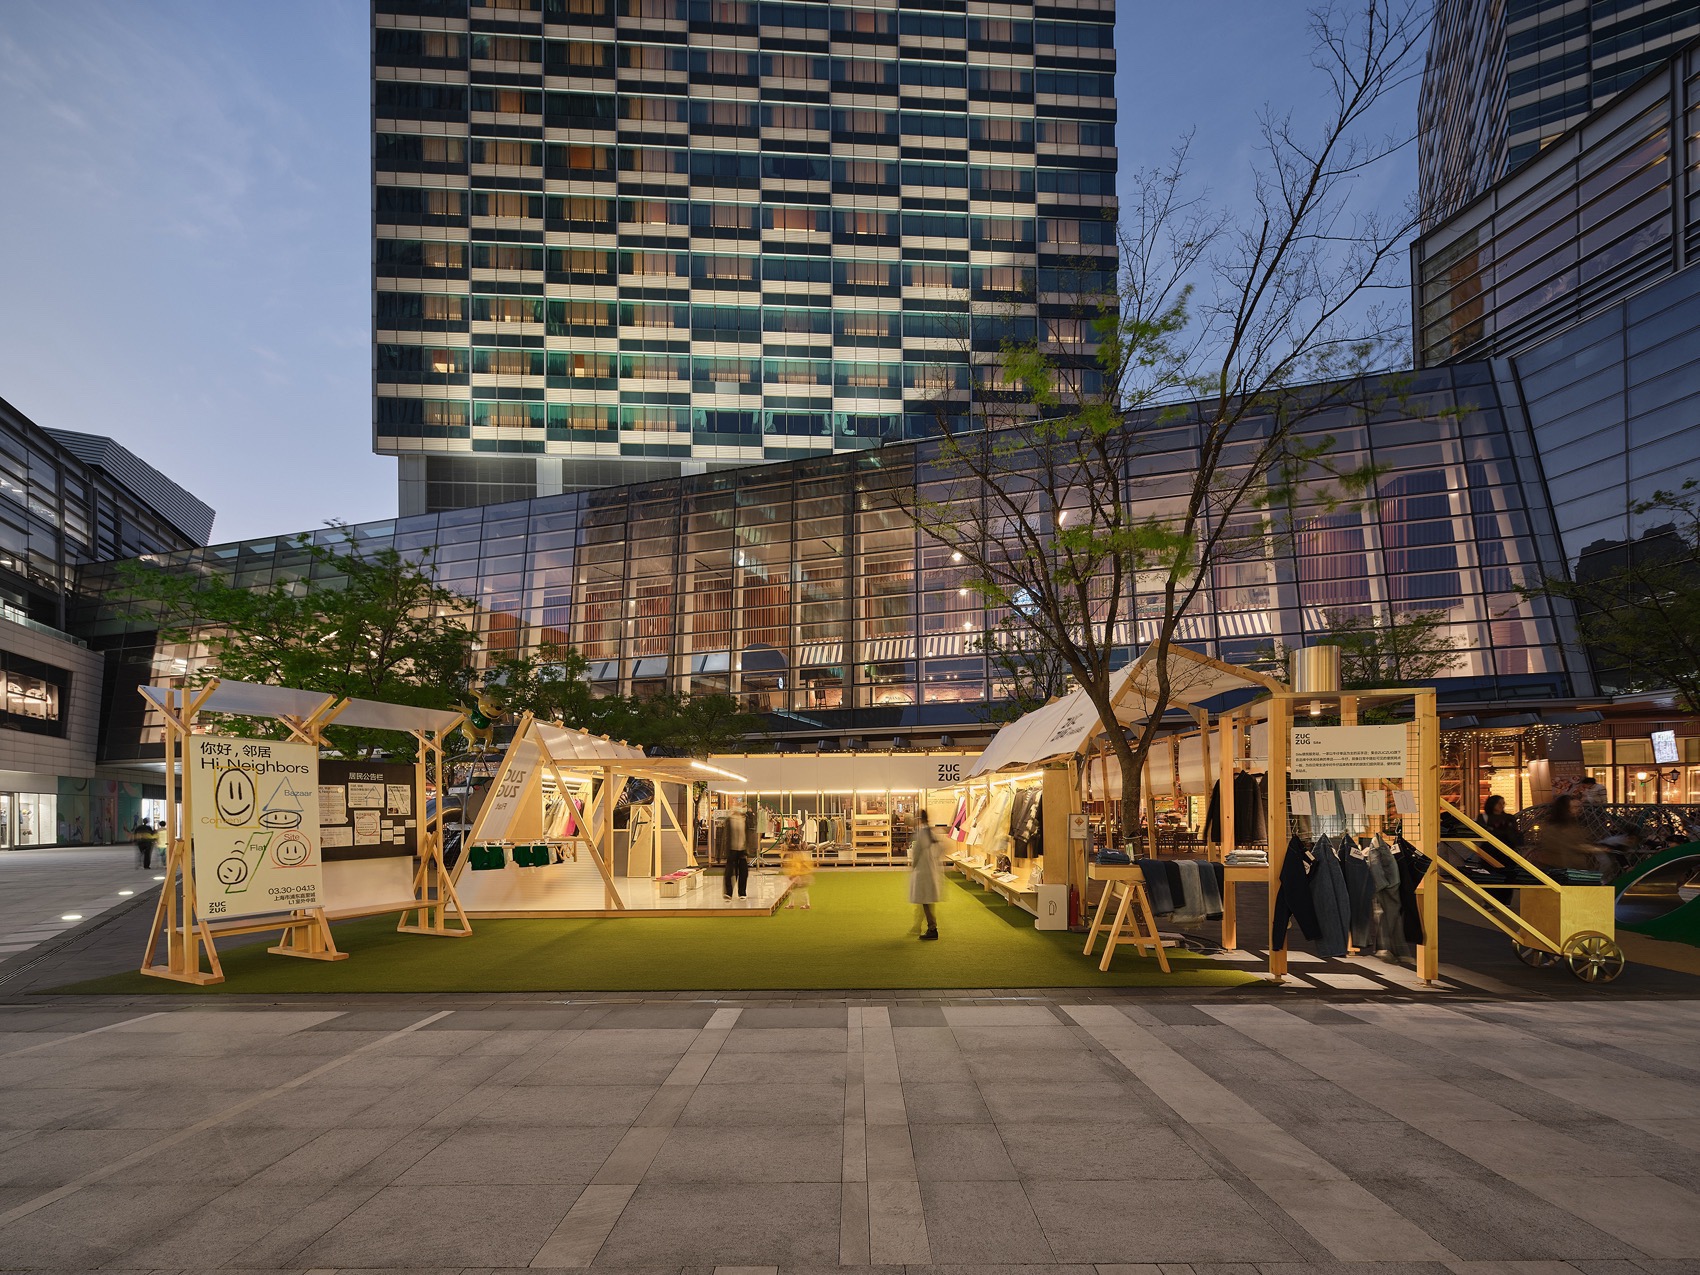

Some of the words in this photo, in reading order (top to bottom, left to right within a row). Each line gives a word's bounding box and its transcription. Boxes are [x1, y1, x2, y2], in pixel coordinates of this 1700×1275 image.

[201, 757, 223, 772] Hi,
[227, 758, 309, 775] Neighbors
[938, 764, 960, 772] ZUC
[348, 772, 384, 781] 居民公告栏
[938, 773, 960, 781] ZUG
[284, 789, 313, 797] Bazaar
[283, 833, 300, 841] Site
[249, 844, 267, 852] Flat
